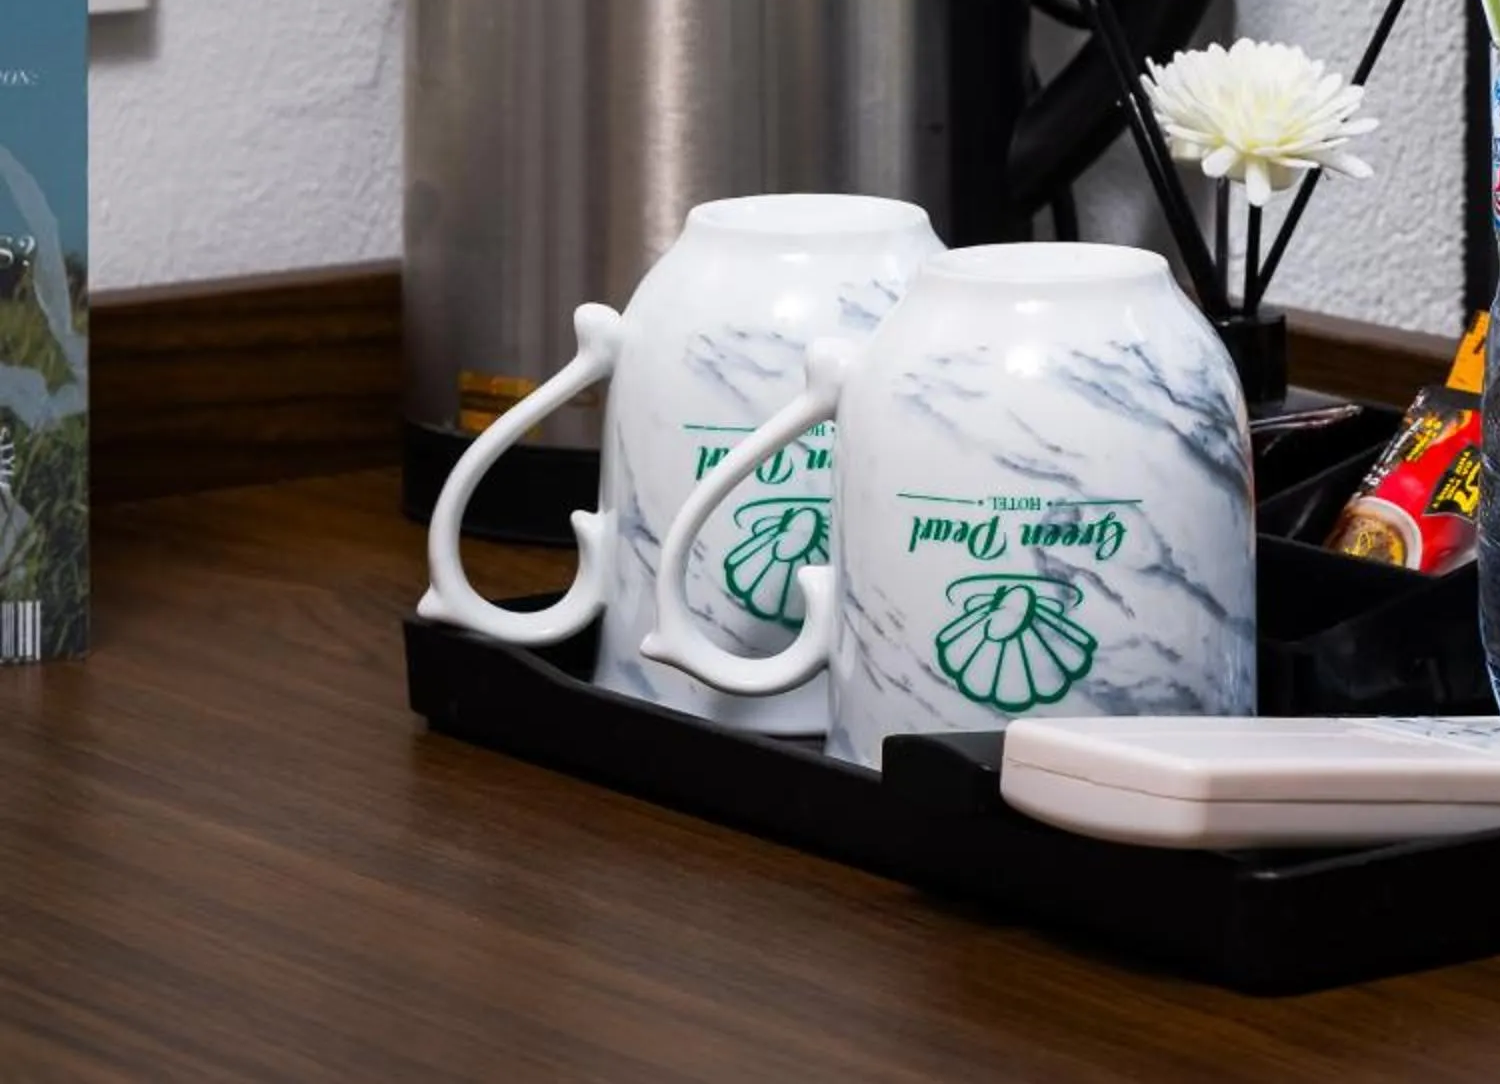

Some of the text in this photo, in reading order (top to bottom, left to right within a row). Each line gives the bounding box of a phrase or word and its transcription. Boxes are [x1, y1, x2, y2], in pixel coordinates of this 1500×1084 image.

[992, 496, 1041, 511] HOTEL
[907, 511, 1127, 561] Green Pearl
